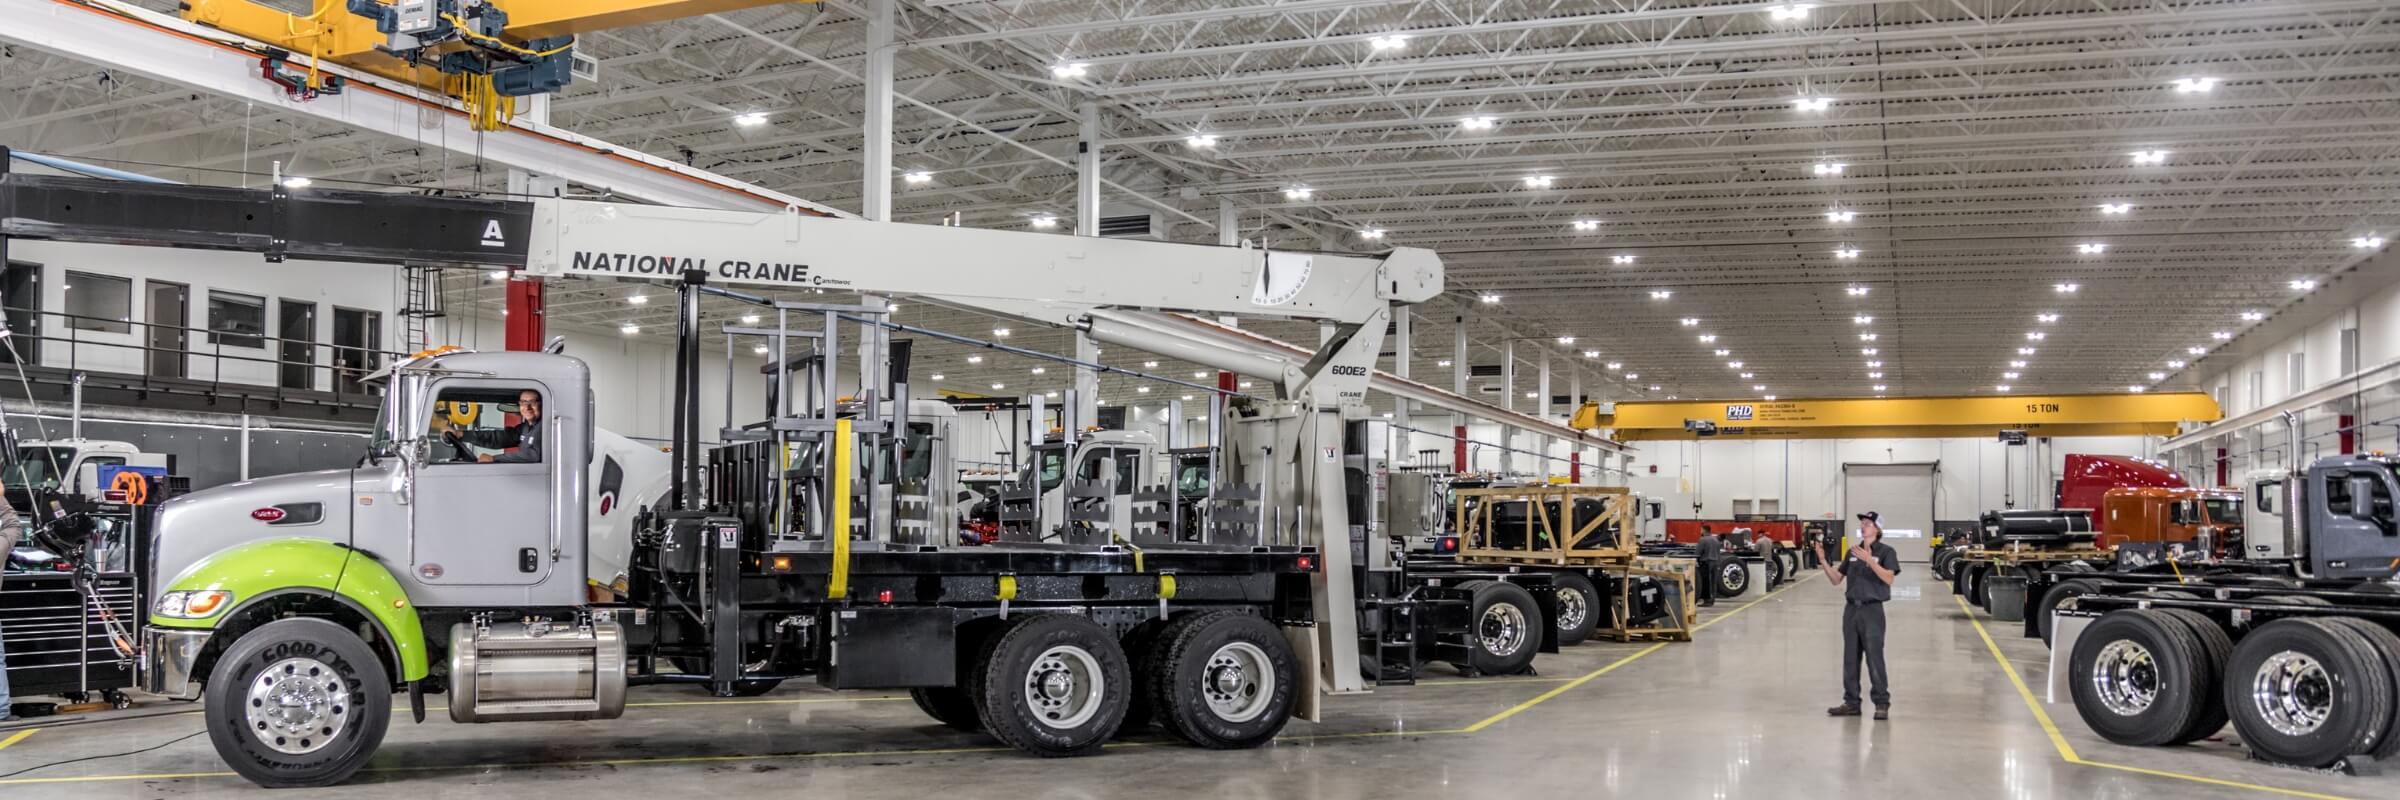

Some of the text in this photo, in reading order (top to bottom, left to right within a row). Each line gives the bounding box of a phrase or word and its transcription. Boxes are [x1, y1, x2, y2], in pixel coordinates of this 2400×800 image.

[573, 251, 808, 282] NATIONAL CRANE
[1332, 365, 1366, 376] 600E2
[1727, 405, 1752, 416] PHD
[2026, 403, 2059, 413] 15 TON
[262, 641, 366, 706] GOODYEAR
